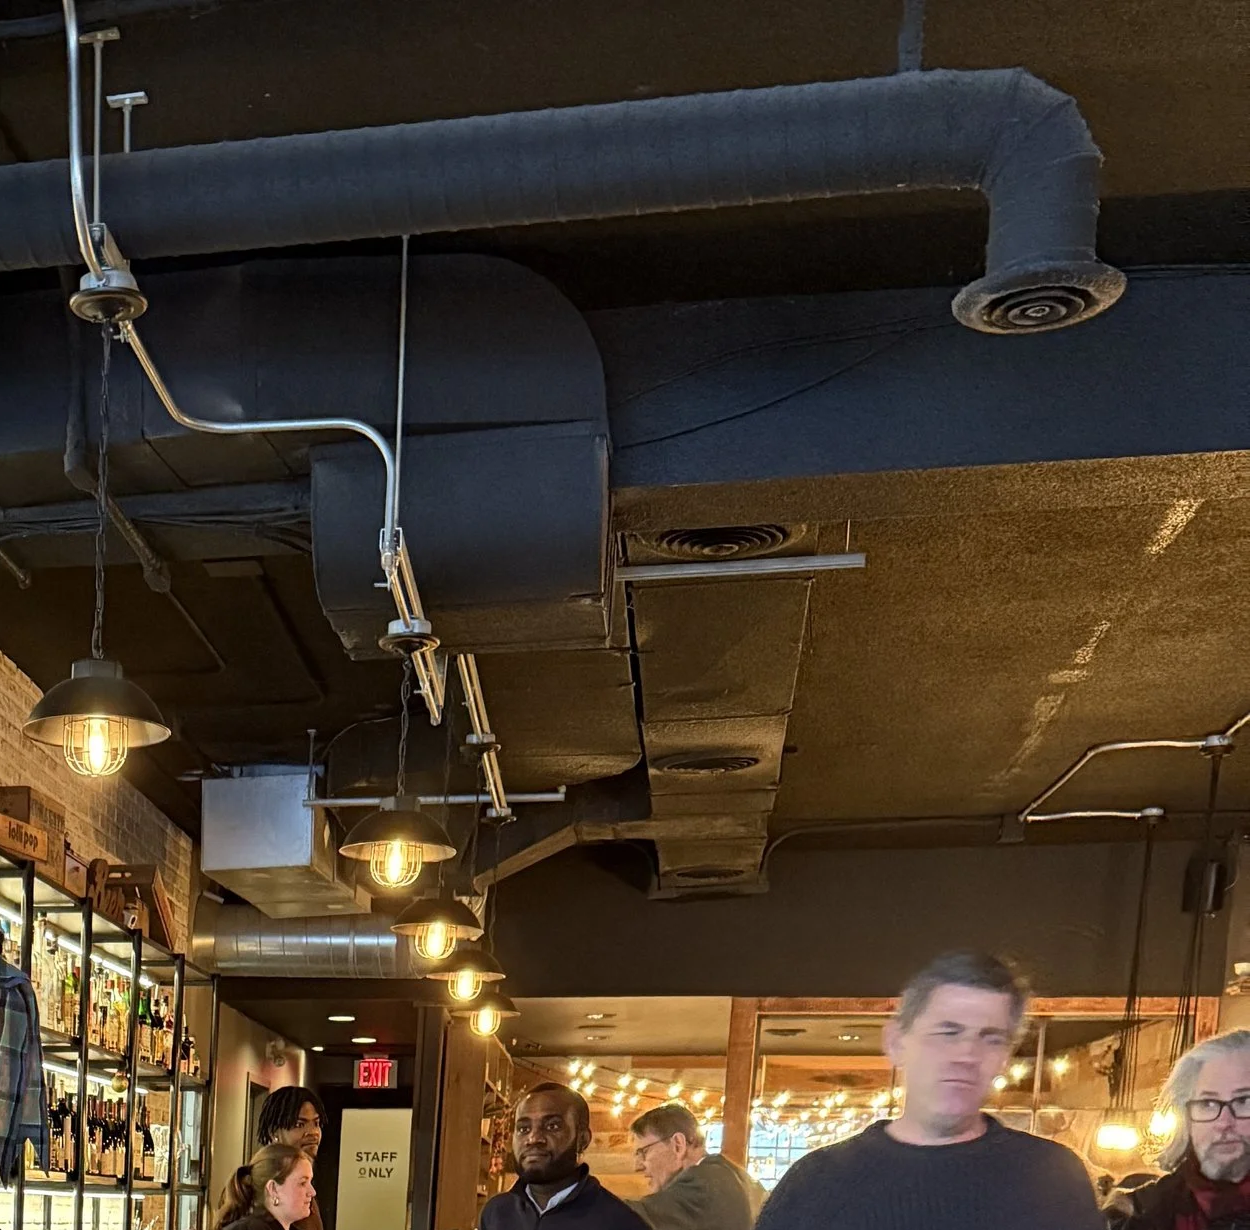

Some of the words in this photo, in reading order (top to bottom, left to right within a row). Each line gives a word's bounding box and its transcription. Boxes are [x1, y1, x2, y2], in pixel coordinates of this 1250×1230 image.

[358, 1061, 392, 1088] EXIT
[355, 1151, 398, 1163] STAFF
[357, 1167, 394, 1179] ONLY
